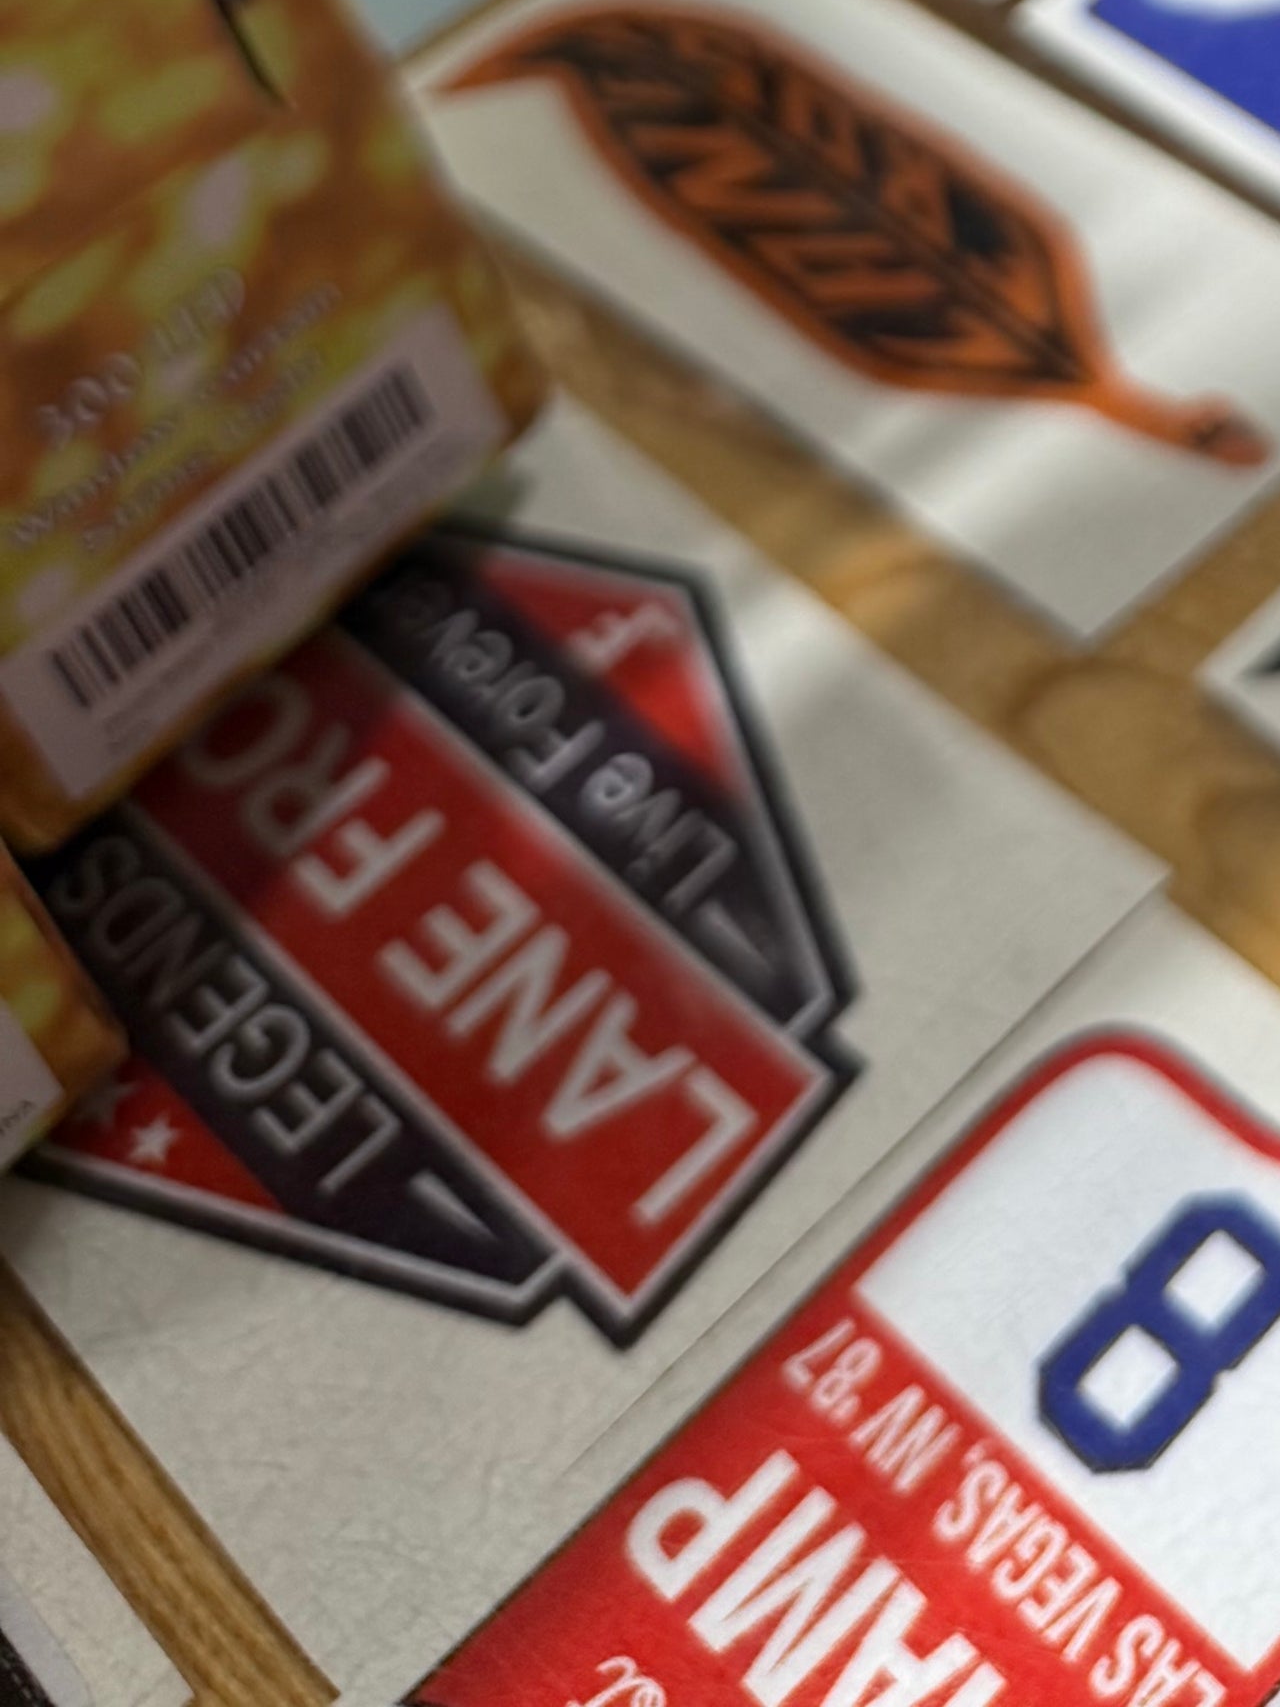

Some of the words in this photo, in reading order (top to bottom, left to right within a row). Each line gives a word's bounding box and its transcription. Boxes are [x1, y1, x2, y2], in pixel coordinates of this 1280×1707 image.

[578, 751, 737, 911] Live
[57, 830, 402, 1191] LEGENDS
[379, 861, 760, 1226] LANE
[849, 1383, 963, 1492] NV
[932, 1439, 1123, 1664] VEGAS,
[625, 1447, 1008, 1707] AMP
